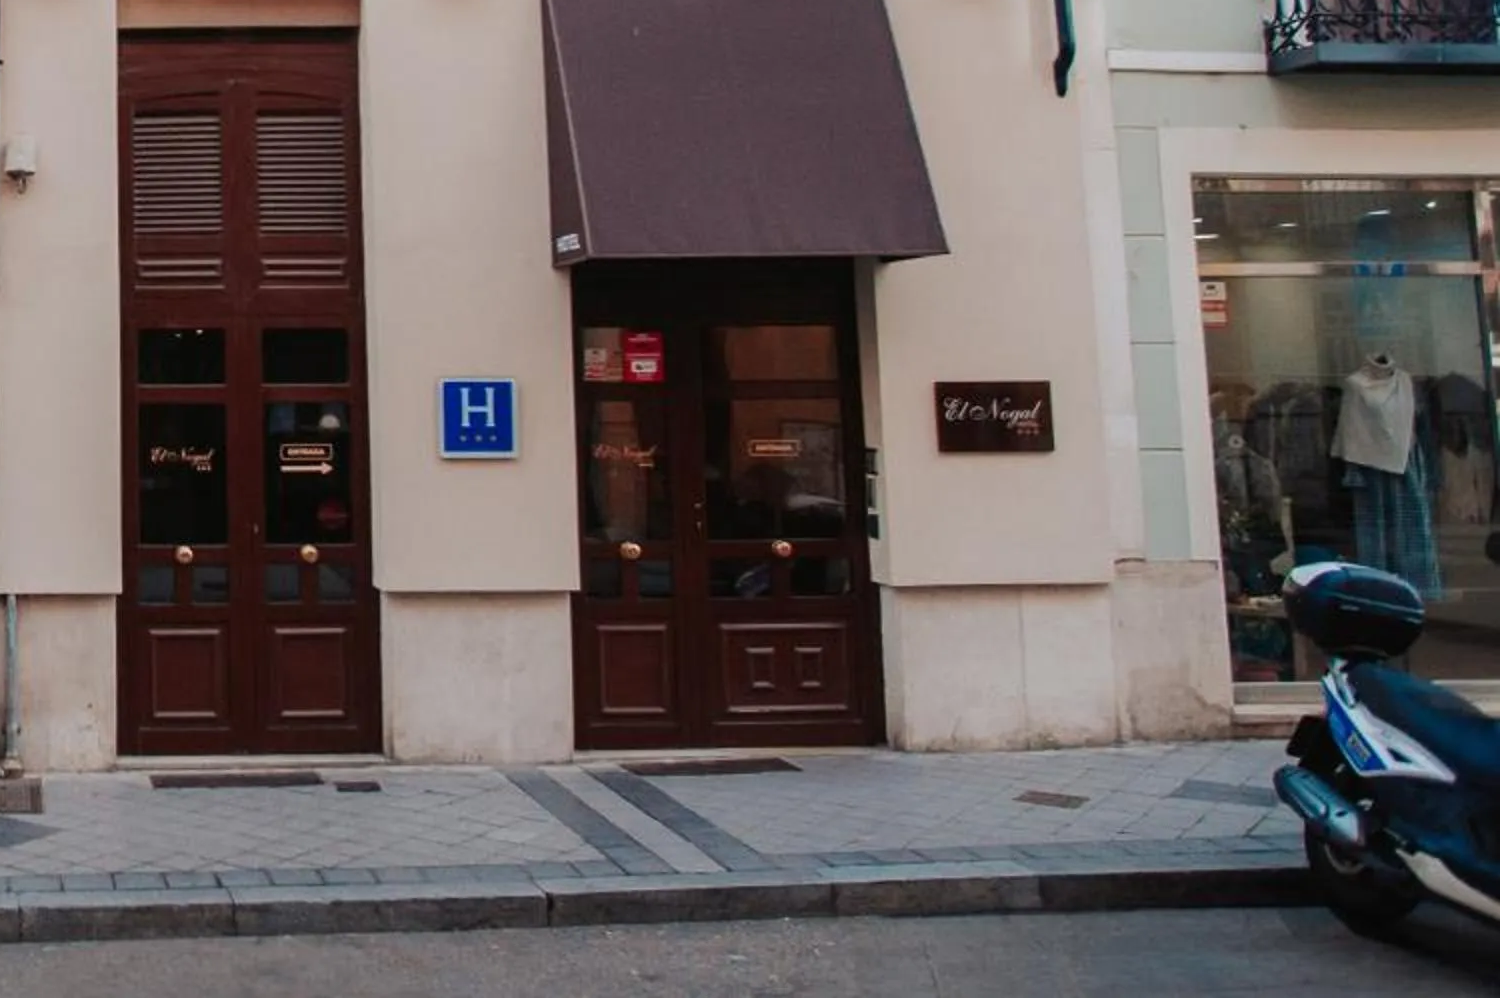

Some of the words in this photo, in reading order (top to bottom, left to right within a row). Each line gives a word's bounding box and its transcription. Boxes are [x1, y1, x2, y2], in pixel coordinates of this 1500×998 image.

[459, 387, 496, 428] H
[943, 396, 970, 422] El
[969, 397, 1044, 429] Nogal
